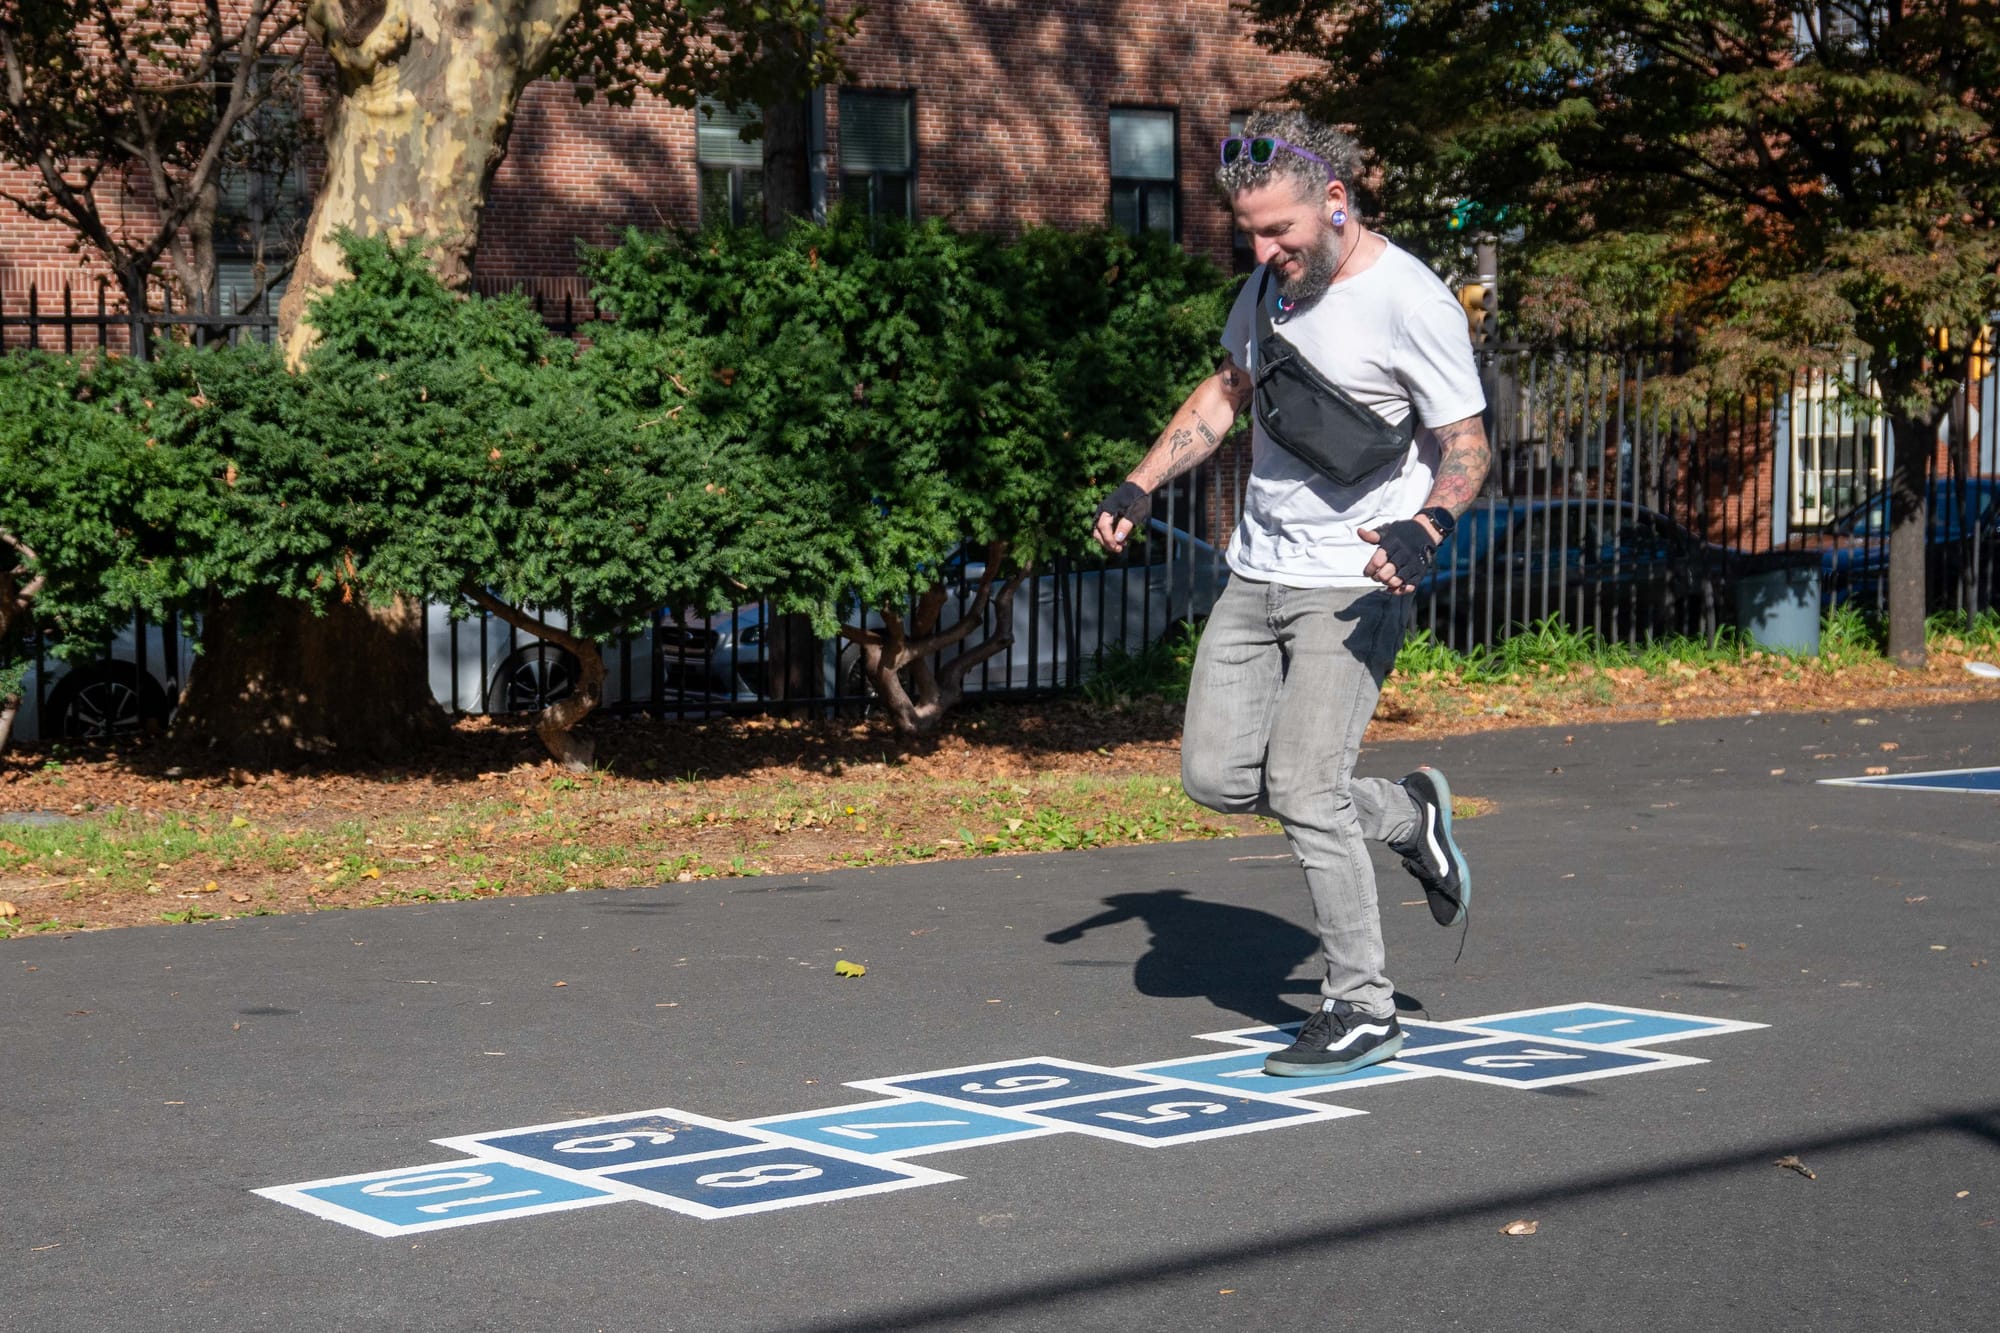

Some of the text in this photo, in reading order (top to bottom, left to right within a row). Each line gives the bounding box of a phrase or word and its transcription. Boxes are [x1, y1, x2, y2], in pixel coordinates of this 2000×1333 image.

[1552, 1018, 1635, 1033] 1
[1462, 1048, 1588, 1068] 2
[960, 1075, 1071, 1094] 6
[1095, 1101, 1228, 1125] 5
[818, 1119, 971, 1140] 7
[552, 1130, 676, 1154] 9
[695, 1163, 824, 1188] 8
[359, 1172, 543, 1214] 10
